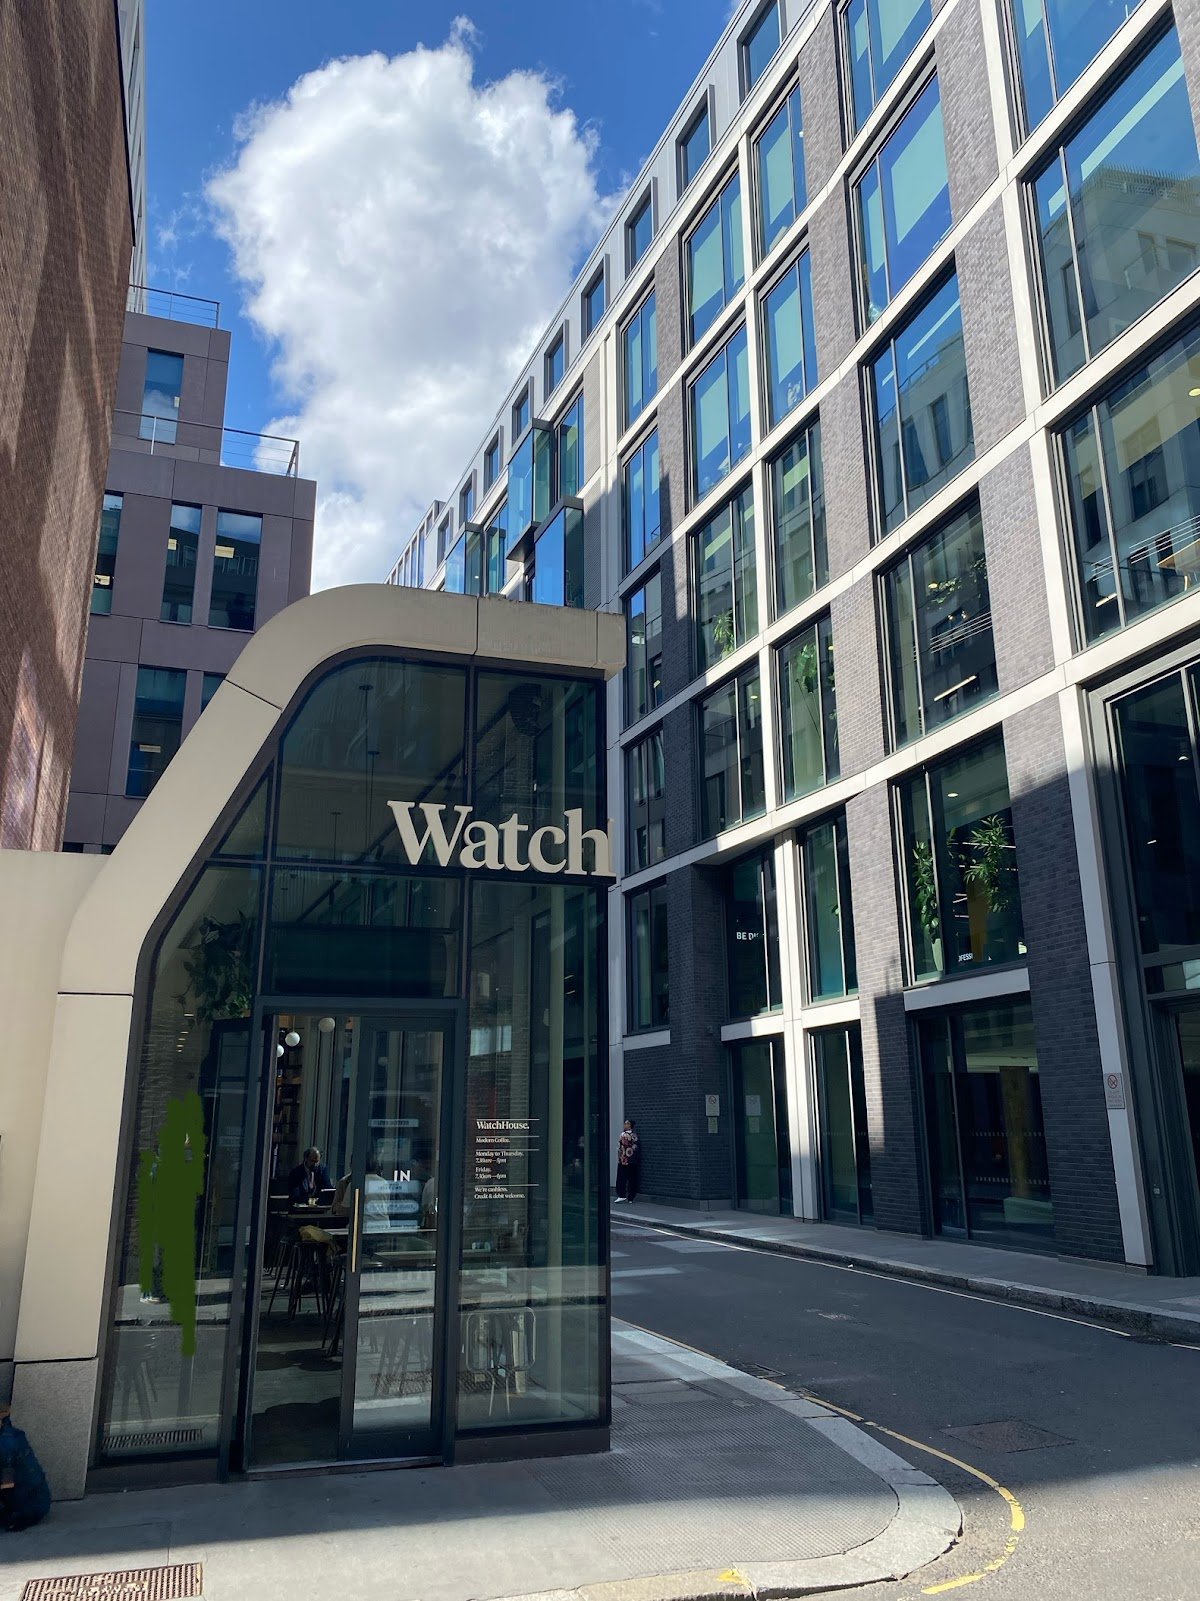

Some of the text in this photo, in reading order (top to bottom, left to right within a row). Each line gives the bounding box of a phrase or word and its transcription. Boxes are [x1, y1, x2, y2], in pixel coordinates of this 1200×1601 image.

[386, 799, 616, 878] Watch
[736, 931, 747, 940] BE
[476, 1121, 530, 1130] WatchHouse.
[393, 1170, 411, 1182] IN
